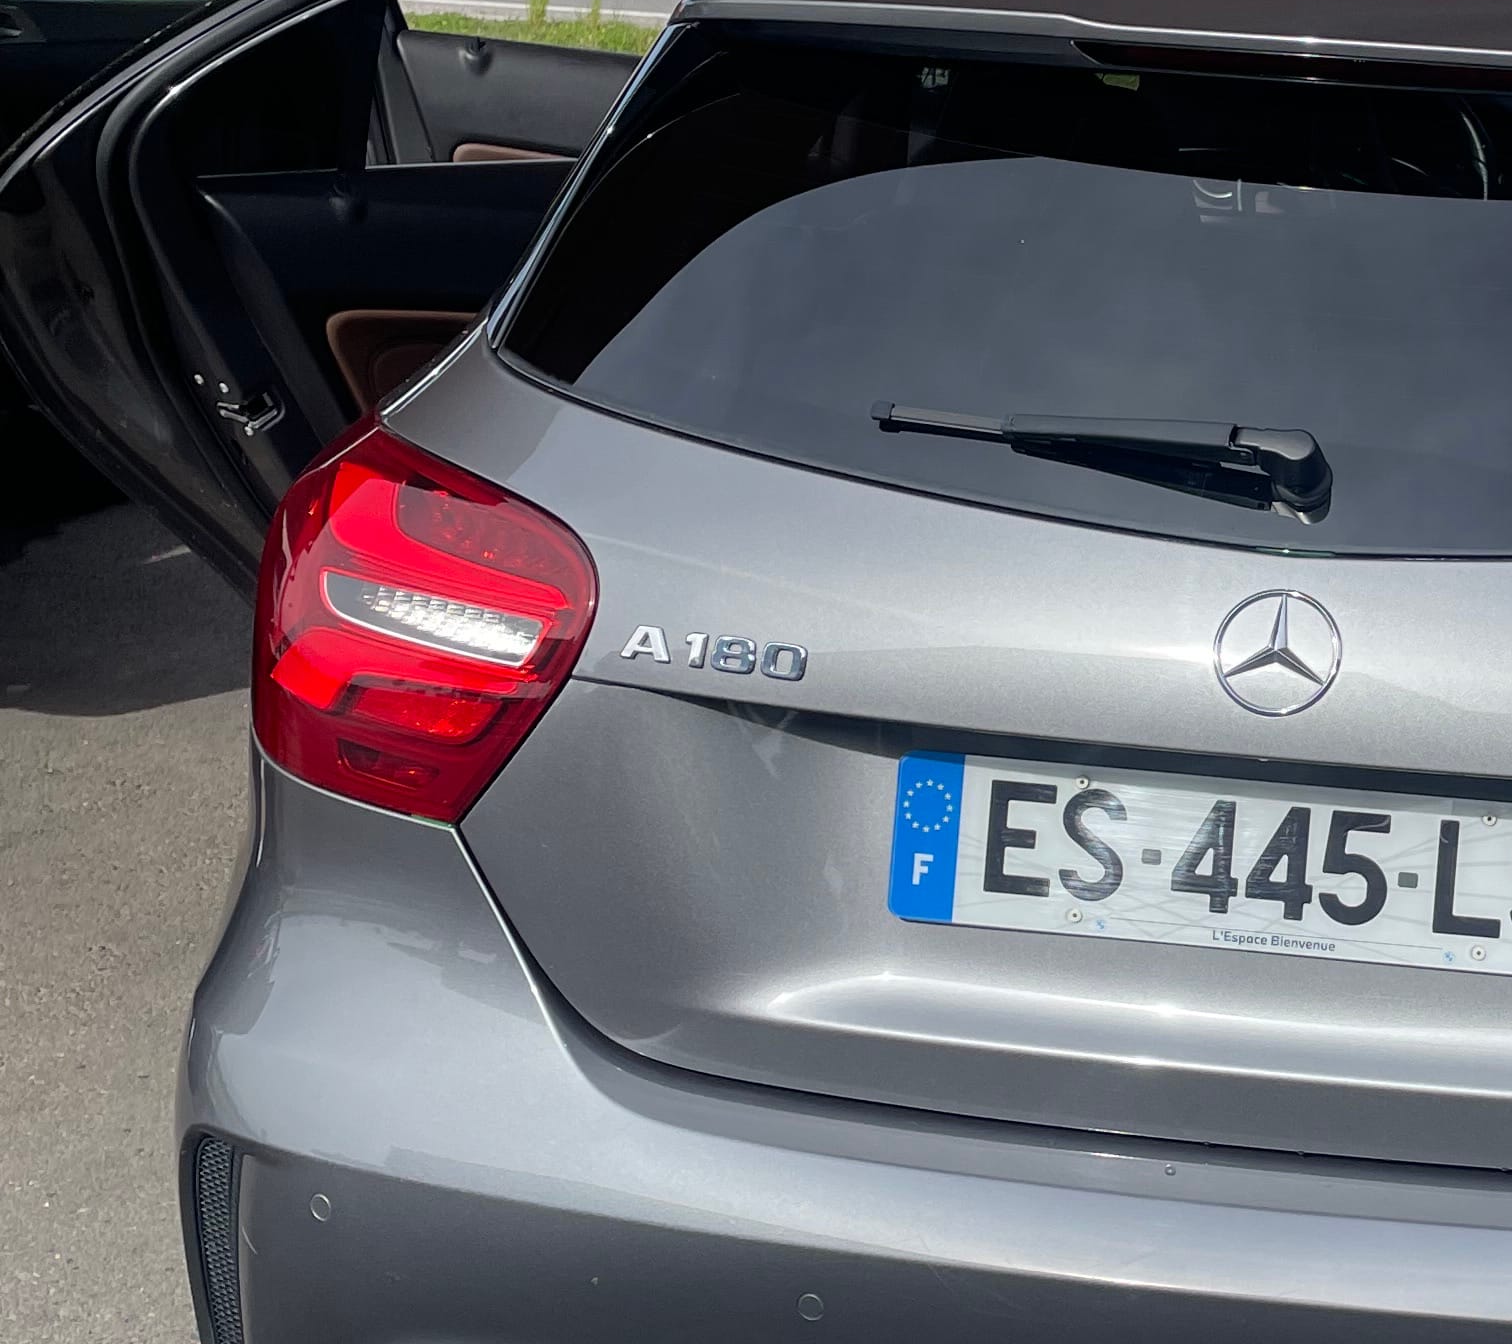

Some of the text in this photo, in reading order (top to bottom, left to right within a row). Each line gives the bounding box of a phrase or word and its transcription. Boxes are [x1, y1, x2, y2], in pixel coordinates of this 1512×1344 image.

[619, 624, 808, 681] A 180
[911, 852, 934, 886] F
[1212, 930, 1336, 952] L'Espace Bienvenue
